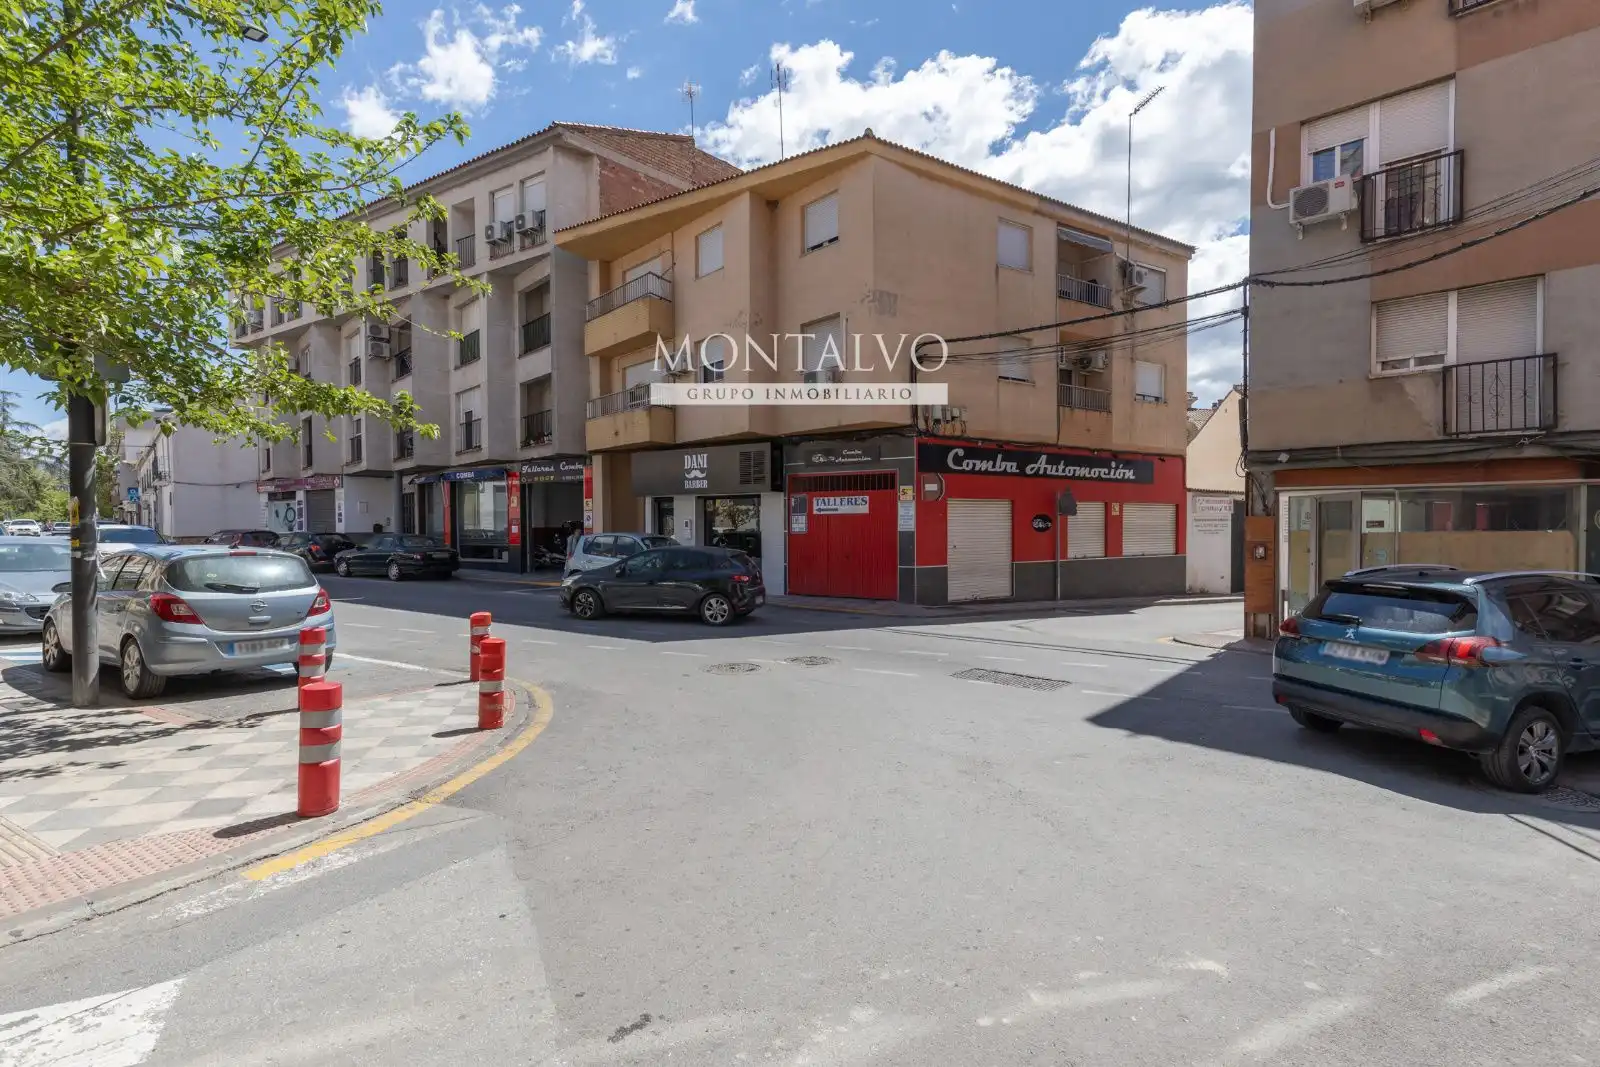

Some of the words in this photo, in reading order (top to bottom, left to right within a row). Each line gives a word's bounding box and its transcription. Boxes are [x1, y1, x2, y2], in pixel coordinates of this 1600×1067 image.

[684, 453, 708, 469] DANI
[946, 448, 1019, 473] Comba
[1025, 454, 1135, 480] Automoción
[456, 471, 475, 480] COMBA
[684, 479, 708, 488] BARBER
[815, 496, 868, 507] TALLERES
